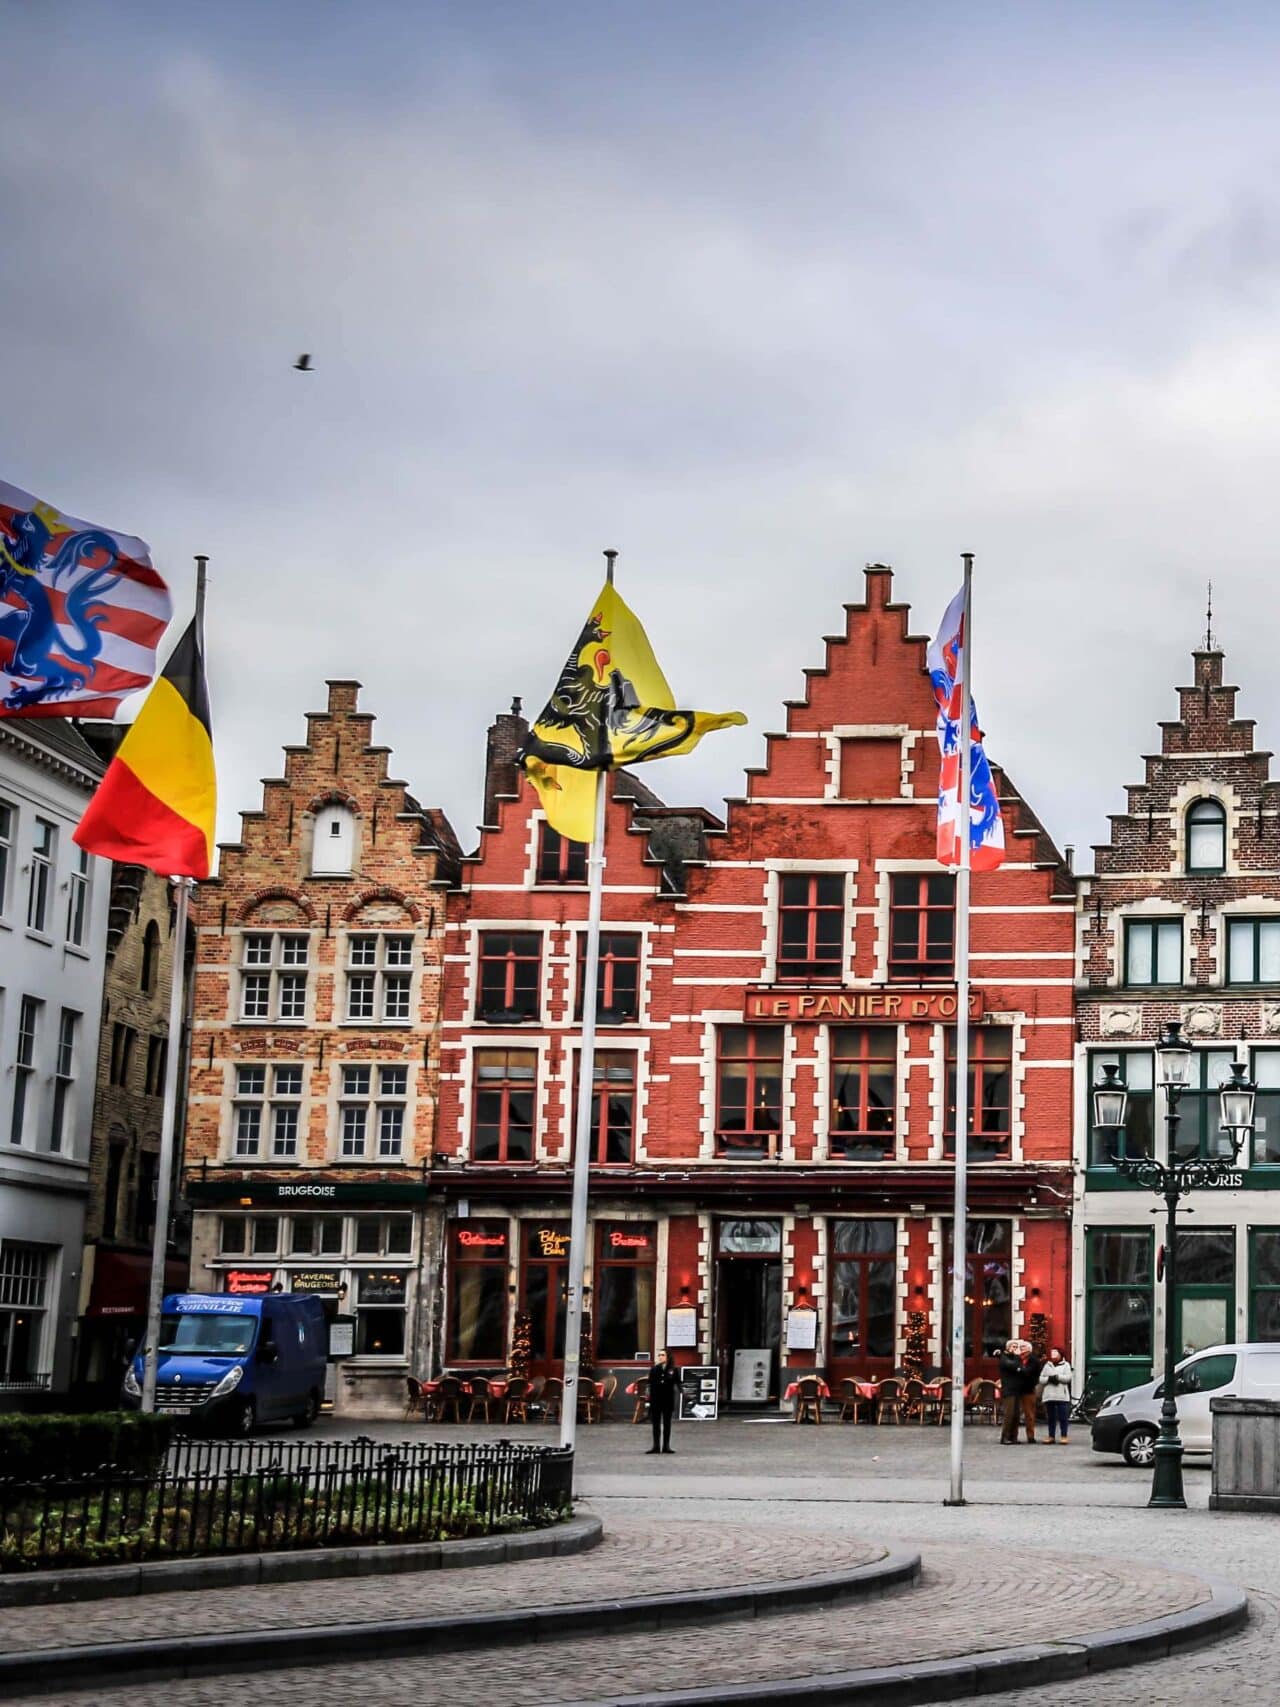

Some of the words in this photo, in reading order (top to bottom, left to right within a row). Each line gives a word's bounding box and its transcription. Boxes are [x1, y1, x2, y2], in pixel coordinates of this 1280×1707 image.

[754, 999, 789, 1017] LE
[798, 995, 902, 1017] PANIER
[278, 1185, 336, 1197] BRUGEOISE
[300, 1272, 335, 1281] TAVERNE
[293, 1280, 341, 1289] BRUGEOISE
